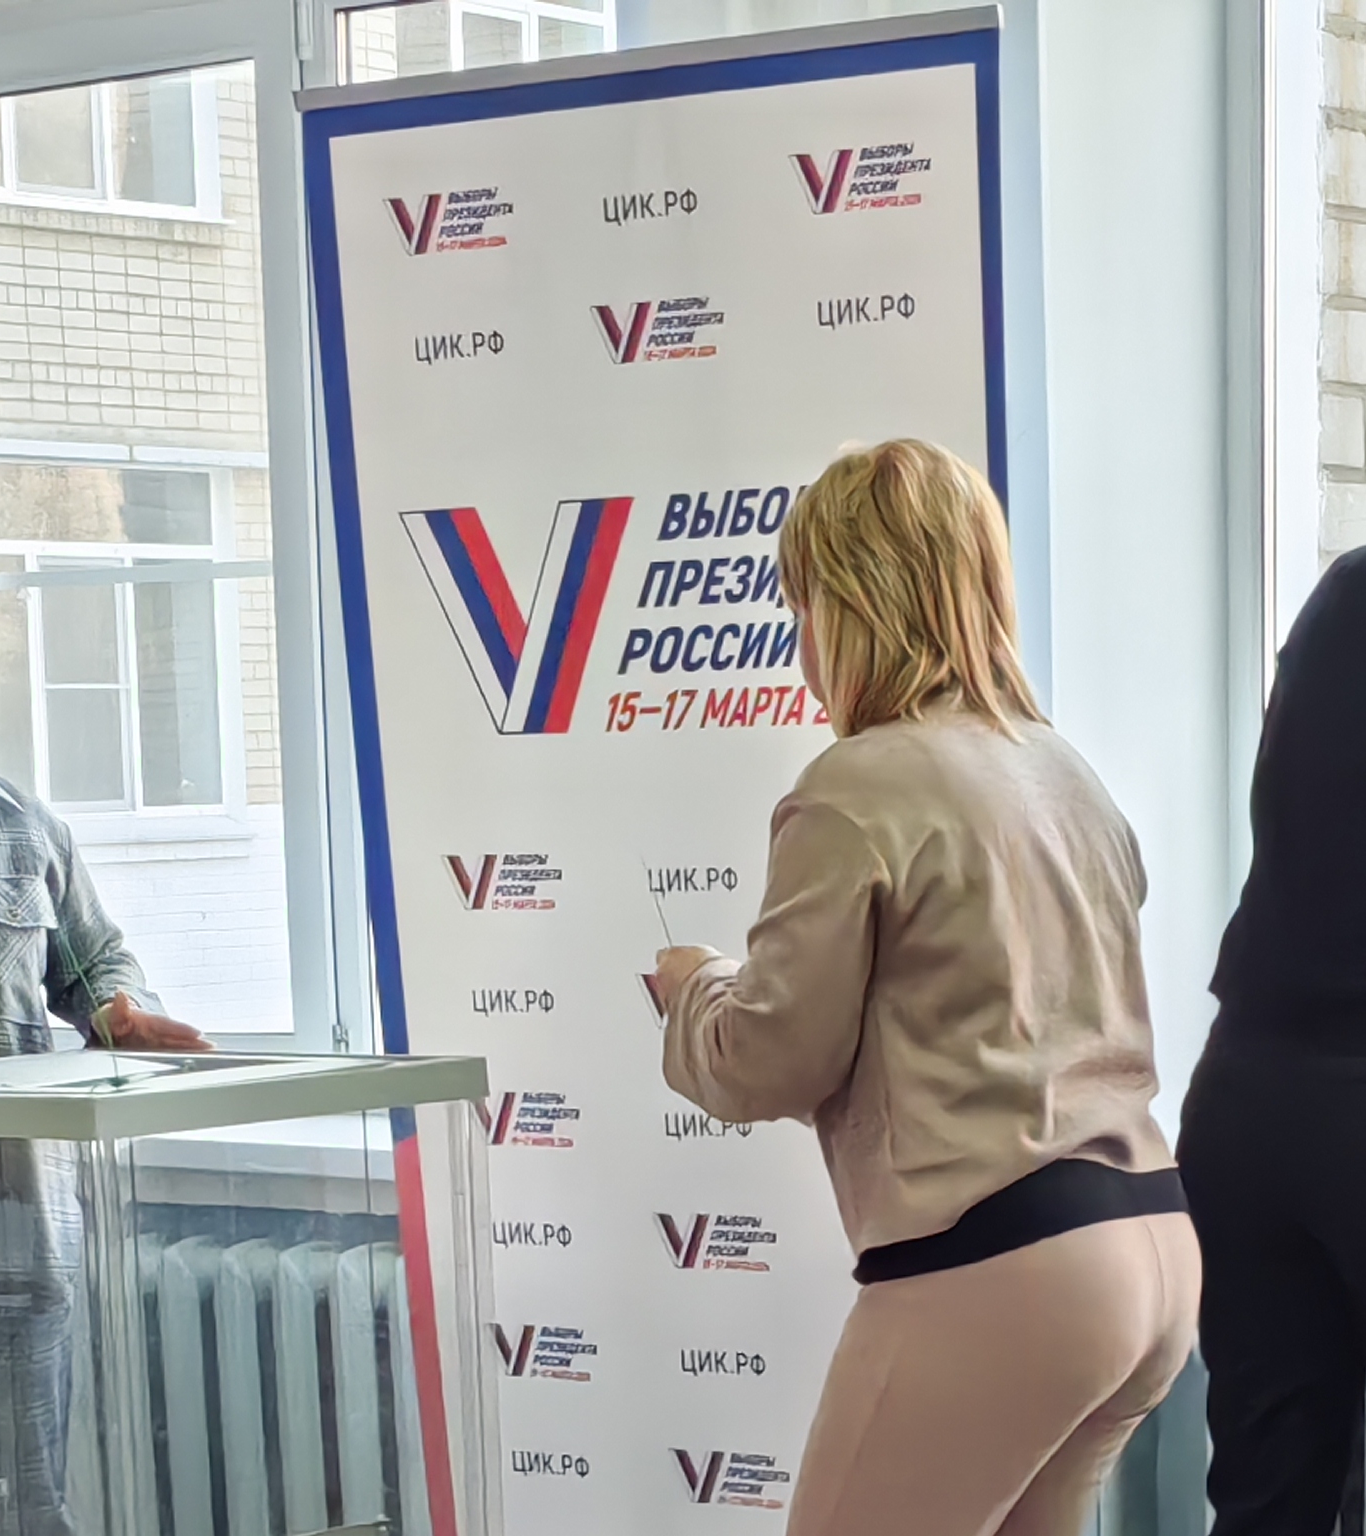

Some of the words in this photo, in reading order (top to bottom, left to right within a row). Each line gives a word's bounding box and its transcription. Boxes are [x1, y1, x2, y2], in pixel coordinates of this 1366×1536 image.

[859, 143, 914, 161] ВЫБОРЫ
[854, 159, 931, 178] ПРЕЗИДЕНТА
[848, 180, 898, 196] РОССИИ
[603, 189, 697, 226] ЦИК.РФ
[818, 293, 914, 330] ЦИК.РФ
[415, 331, 504, 365] ЦИК.РФ
[657, 486, 805, 541] ВЫБО
[637, 555, 784, 609] ПРЕЗИ
[617, 621, 797, 675] РОССИИ
[699, 684, 807, 729] МАРТА
[648, 868, 737, 896] ЦИК.РФ
[473, 990, 554, 1017] ЦИК.РФ
[492, 1222, 572, 1248] ЦИК.РФ
[681, 1350, 765, 1376] ЦИК.РФ
[511, 1451, 589, 1478] ЦИК.РФ
